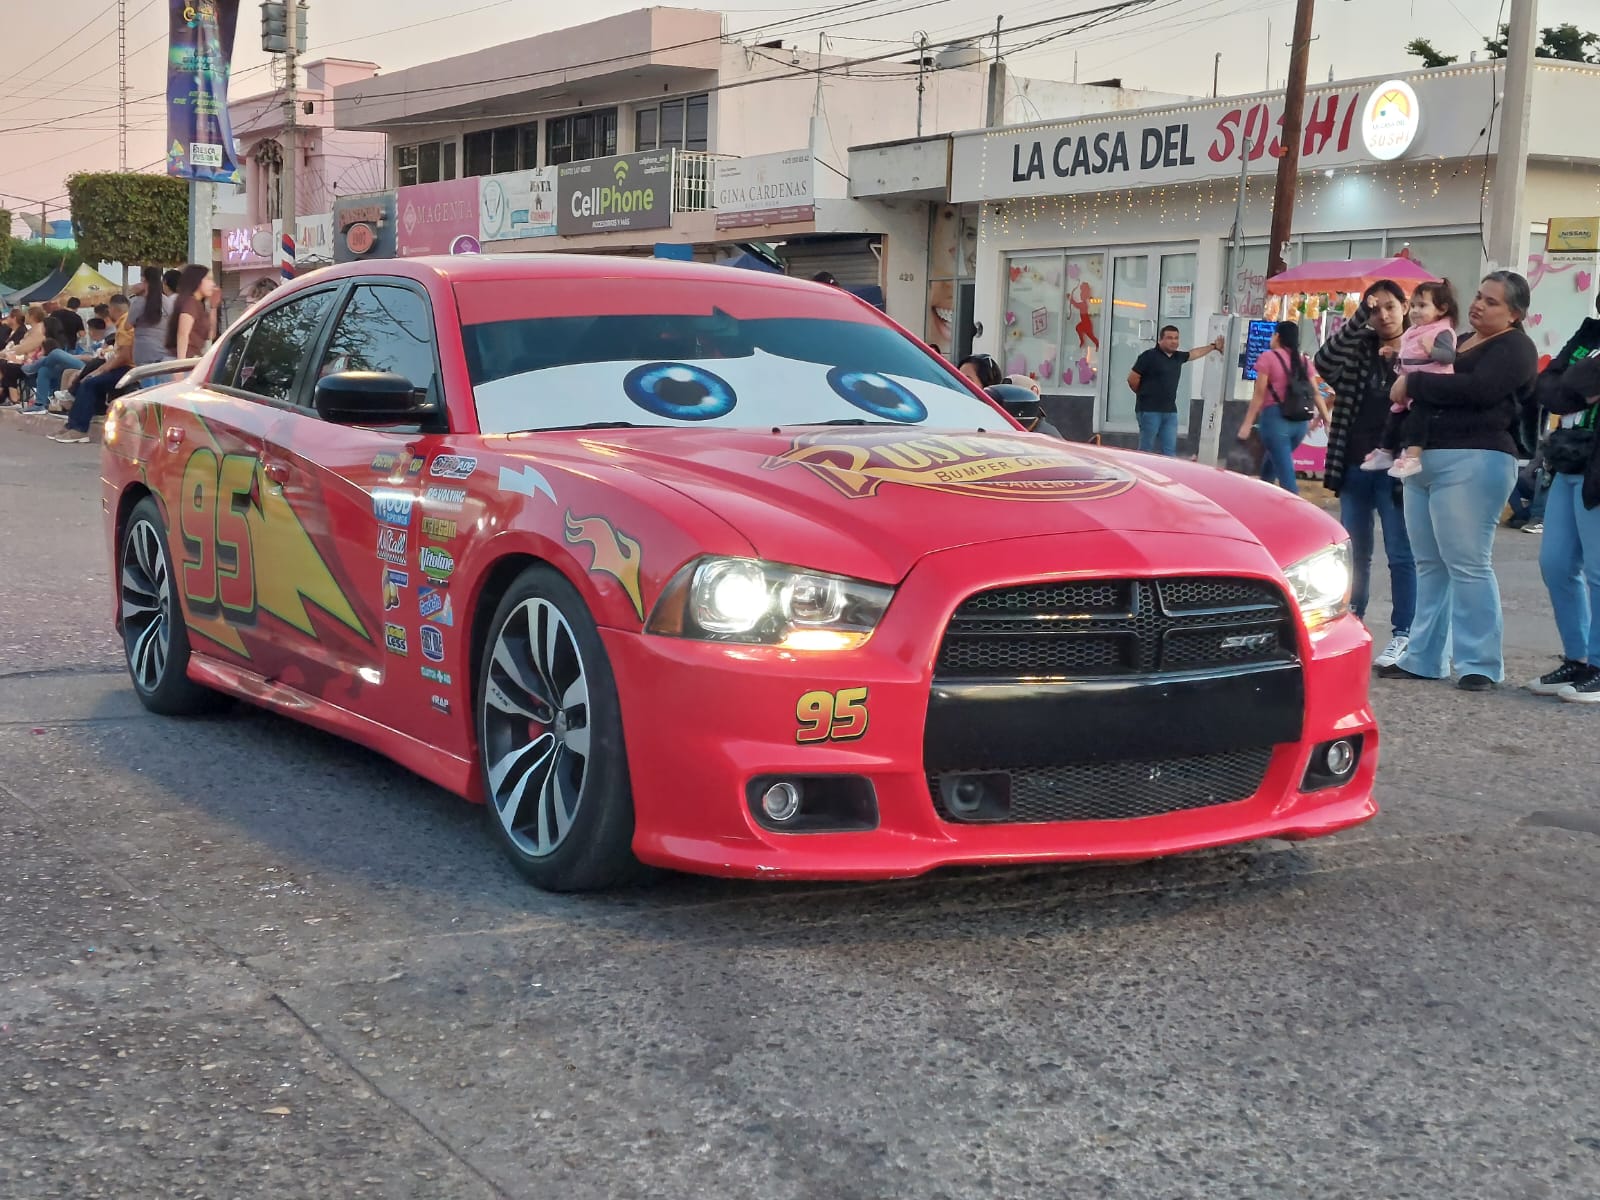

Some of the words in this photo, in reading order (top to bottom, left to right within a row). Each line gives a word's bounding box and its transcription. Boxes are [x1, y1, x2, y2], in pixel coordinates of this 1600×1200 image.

[1012, 141, 1045, 182] LA
[1052, 131, 1130, 178] CASA
[1140, 124, 1195, 170] DEL
[571, 185, 654, 218] CellPhone
[720, 187, 746, 204] GINA
[749, 180, 807, 201] CARDENAS
[416, 200, 473, 224] MAGENTA
[935, 462, 1010, 482] BUMPER
[181, 447, 257, 616] 95
[1220, 632, 1274, 650] SRT
[796, 687, 869, 743] 95
